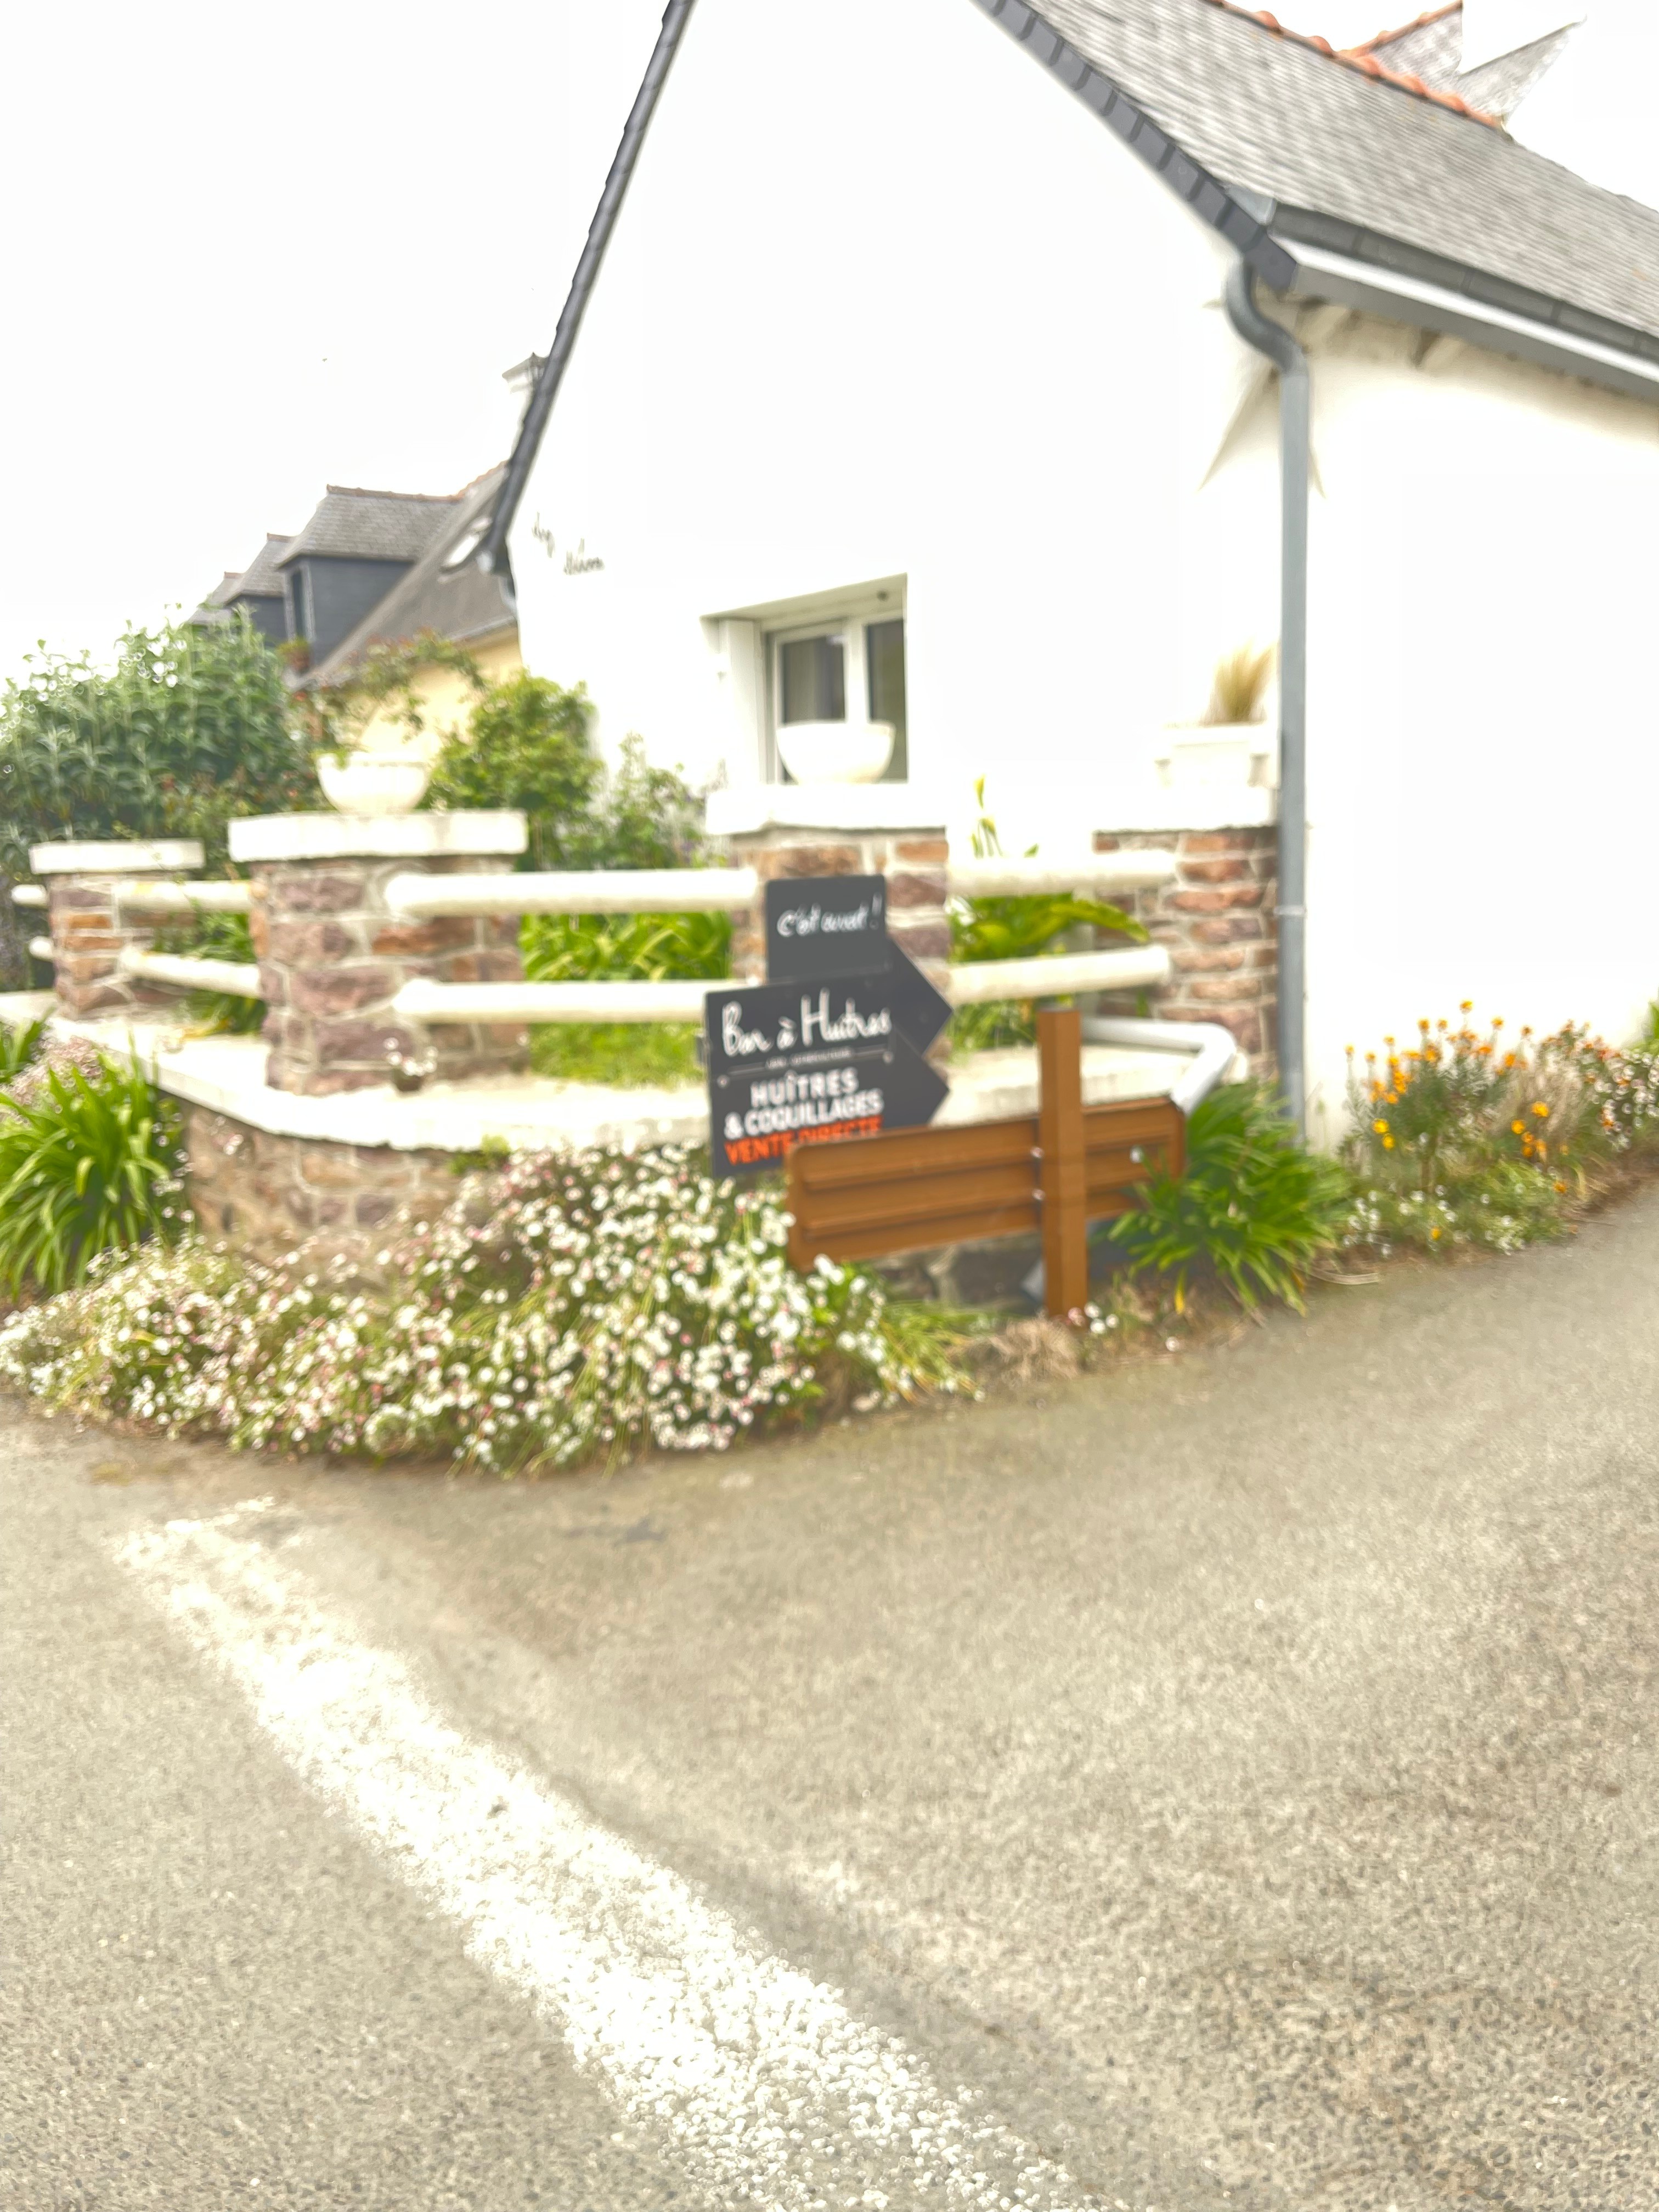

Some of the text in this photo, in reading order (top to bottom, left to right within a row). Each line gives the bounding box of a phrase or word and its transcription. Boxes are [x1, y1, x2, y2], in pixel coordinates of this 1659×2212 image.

[723, 1001, 772, 1056] Bar
[777, 1016, 797, 1050] à
[751, 1068, 859, 1107] HUÎTRES
[724, 1088, 884, 1140] & COQUILLAGES
